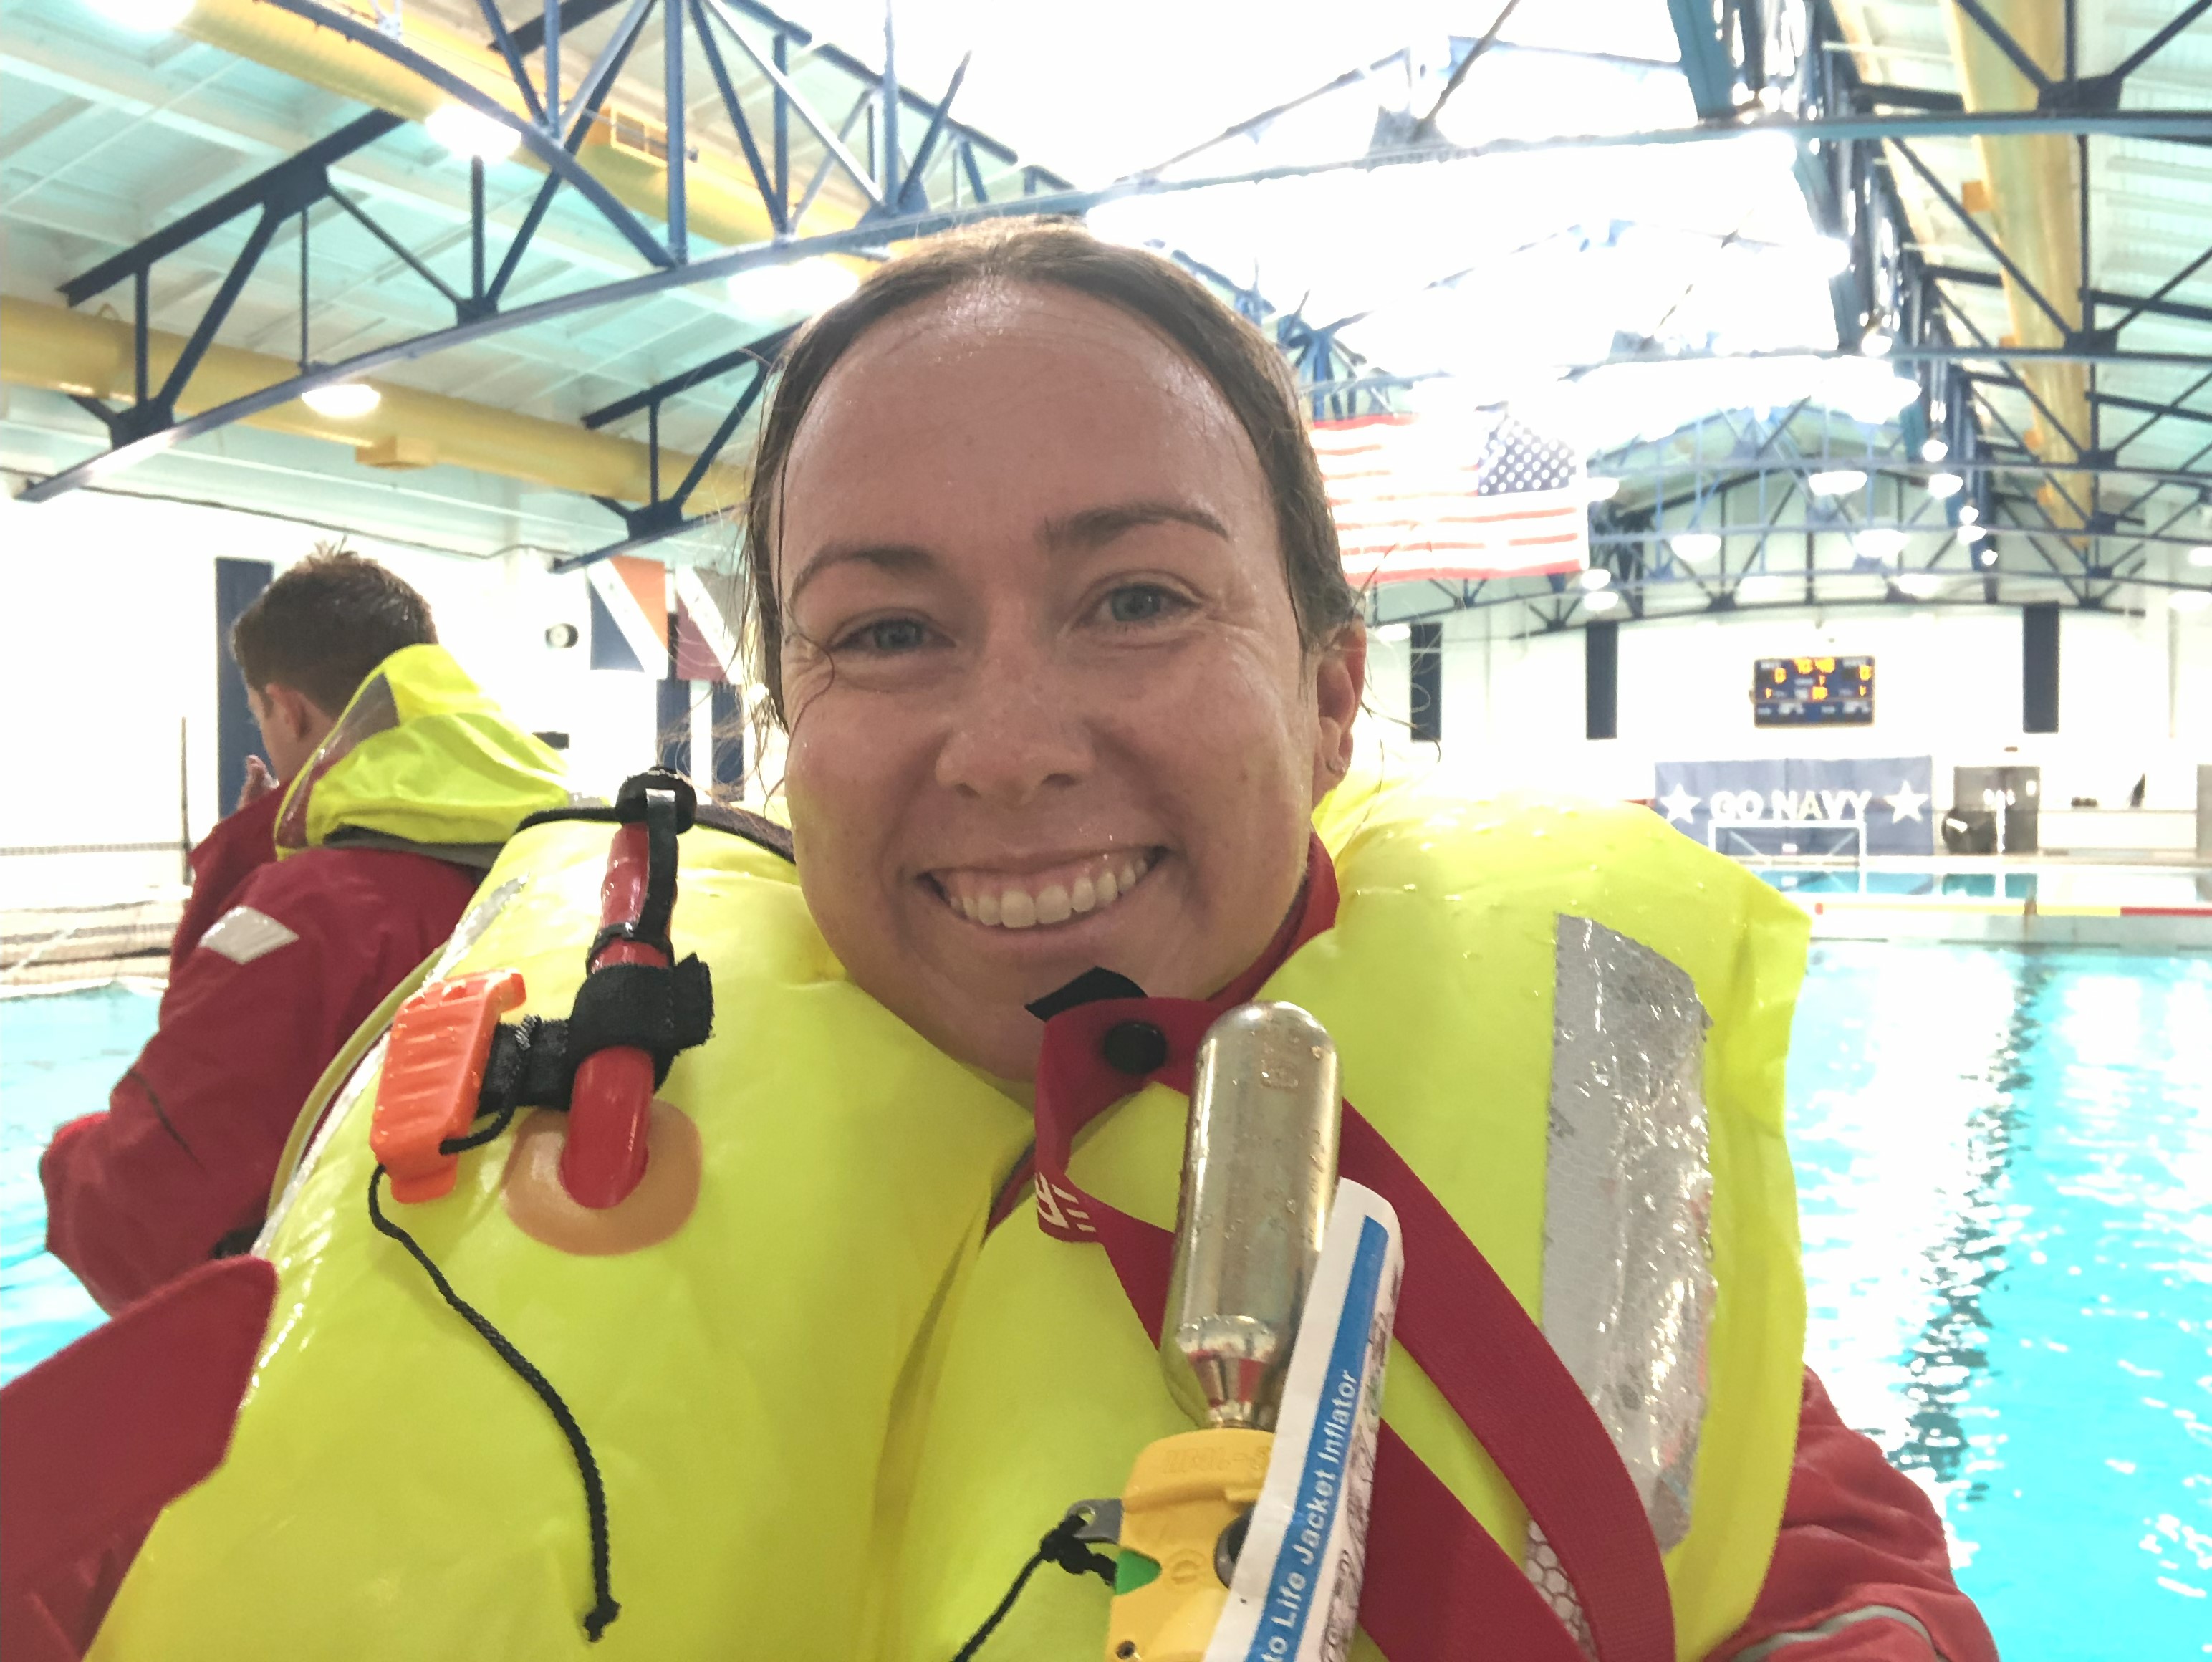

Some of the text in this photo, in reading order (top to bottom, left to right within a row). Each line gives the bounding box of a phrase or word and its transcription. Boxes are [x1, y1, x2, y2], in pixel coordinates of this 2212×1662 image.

[1711, 790, 1872, 821] GO NAVY
[1270, 1572, 1306, 1628] Life
[1292, 1470, 1336, 1565] Jacket
[1317, 1369, 1357, 1464] Inflator
